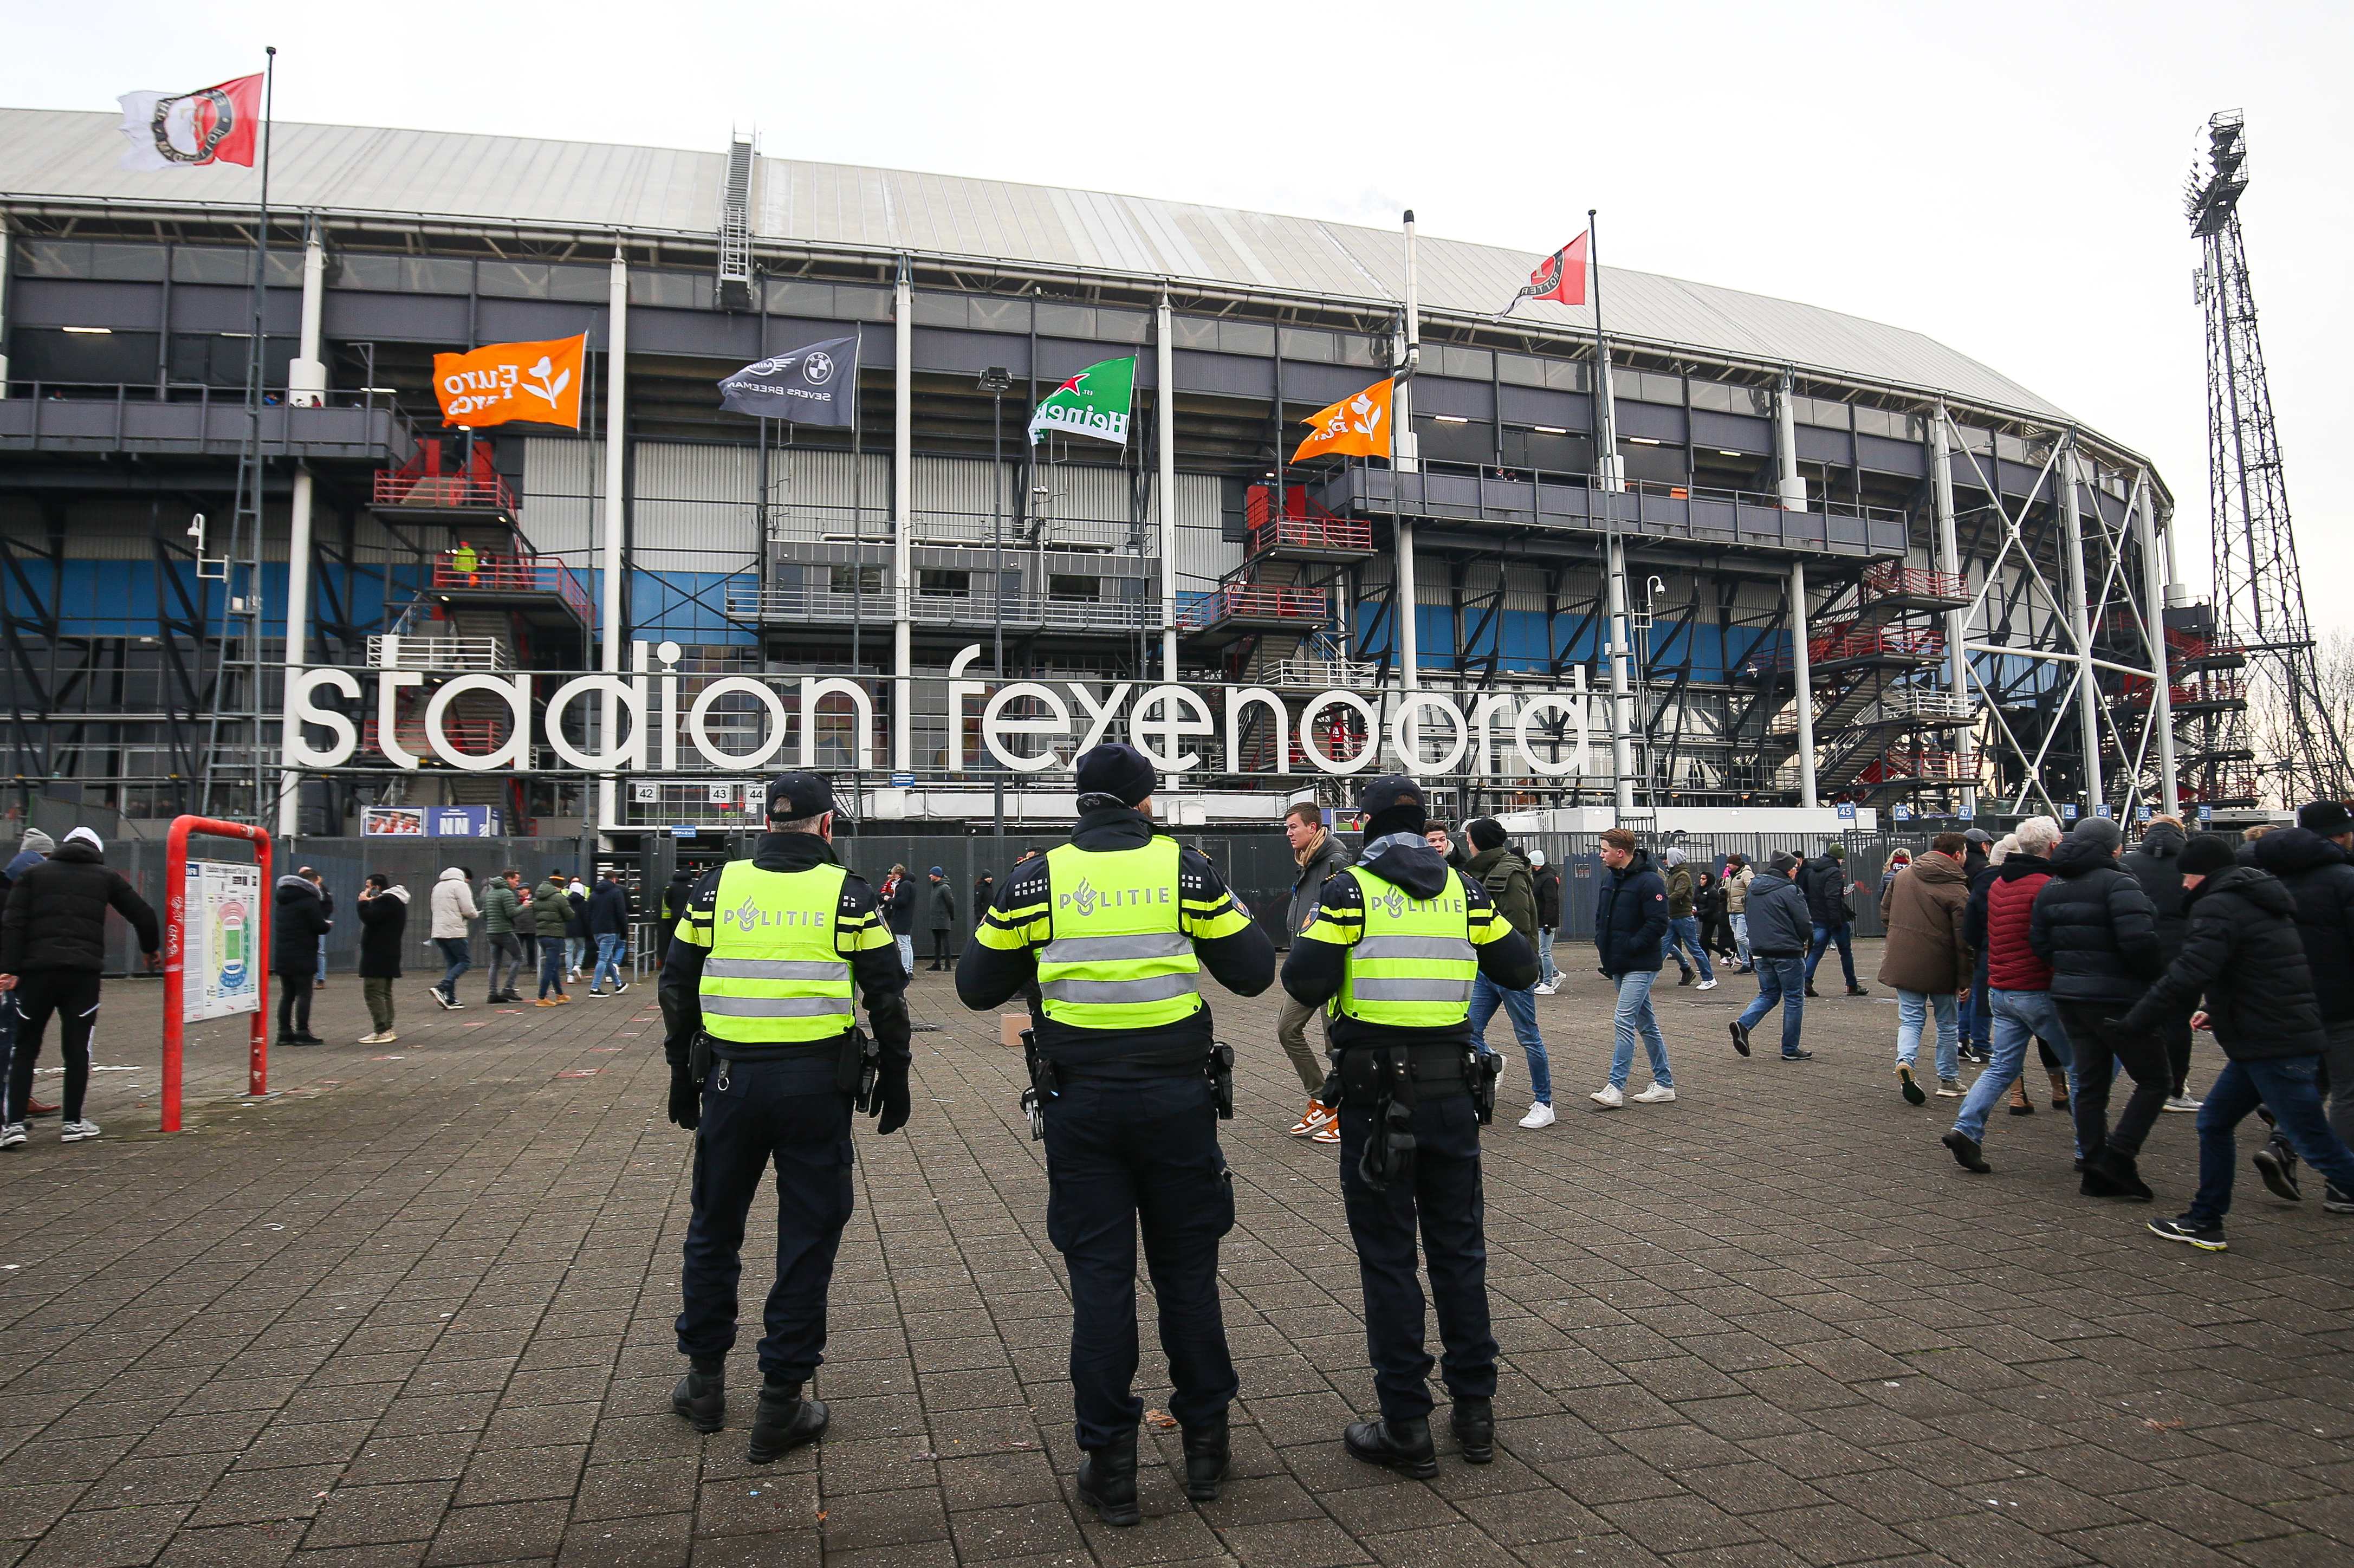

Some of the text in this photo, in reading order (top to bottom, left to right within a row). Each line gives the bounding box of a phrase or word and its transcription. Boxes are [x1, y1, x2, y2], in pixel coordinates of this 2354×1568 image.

[293, 634, 1589, 774] stadion feyenoord
[640, 789, 653, 798] 42
[713, 789, 727, 799] 43
[749, 790, 763, 799] 44
[1839, 807, 1851, 816] 45
[1897, 809, 1907, 817] 46
[1960, 808, 1969, 817] 47
[2065, 808, 2075, 816] 48
[439, 817, 470, 835] NN
[1059, 888, 1169, 916] POLITIE
[1371, 897, 1462, 918] POLITIE
[724, 910, 825, 931] POLITIE
